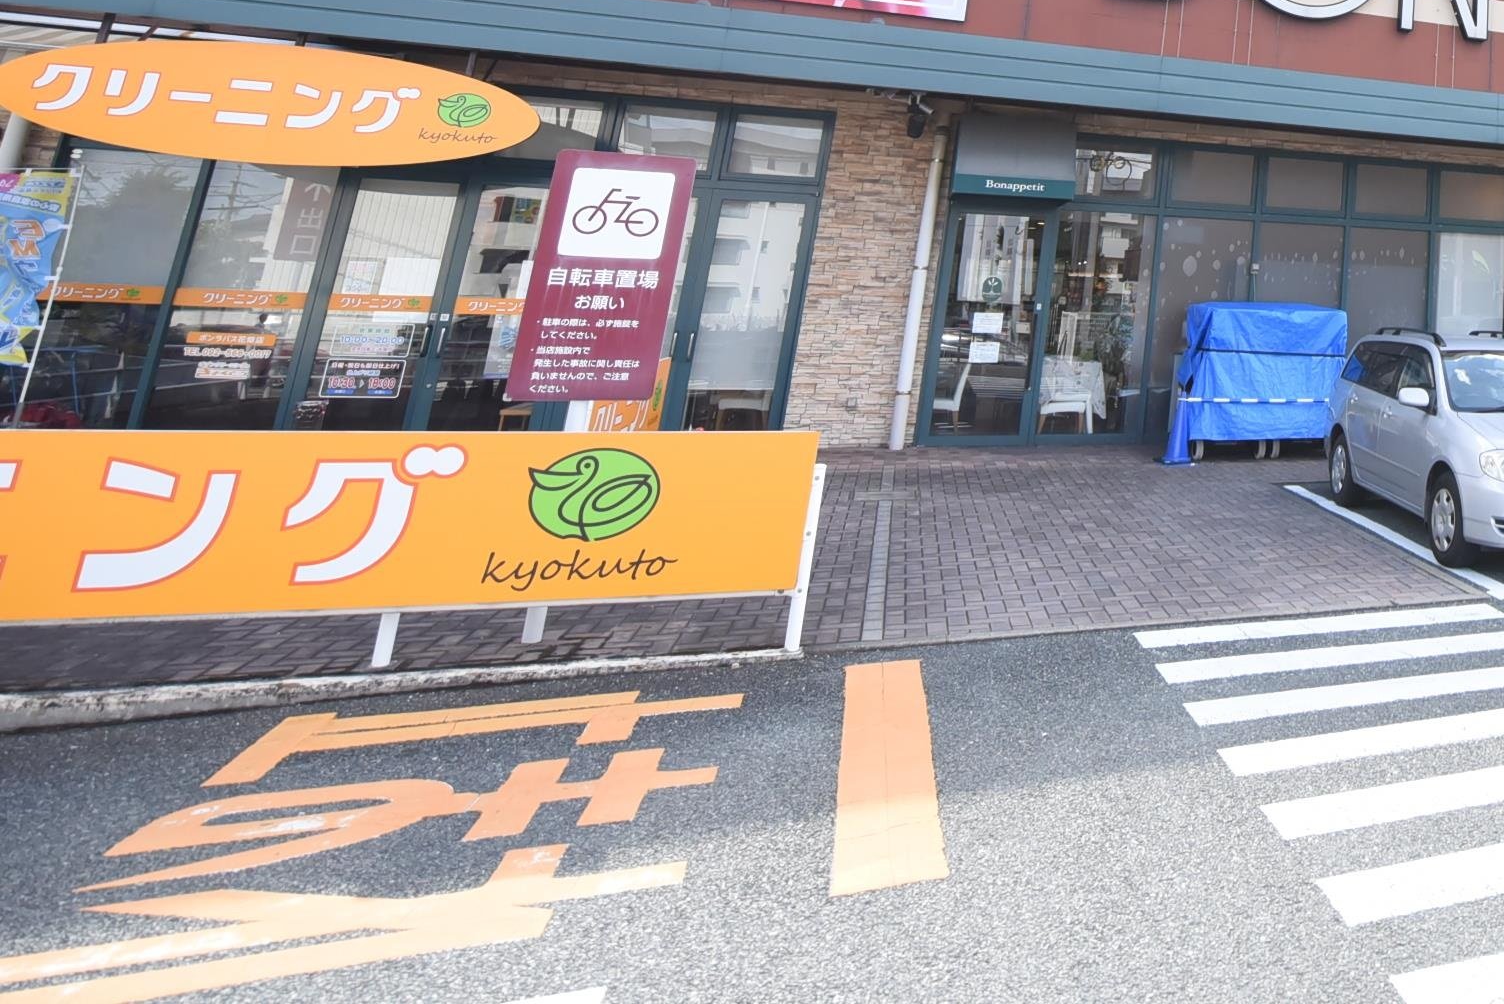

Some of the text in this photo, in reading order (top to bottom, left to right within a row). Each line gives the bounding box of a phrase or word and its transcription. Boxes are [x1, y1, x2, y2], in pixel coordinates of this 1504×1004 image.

[32, 62, 422, 134] クリーニング
[417, 127, 498, 144] kyokuto
[985, 179, 1046, 192] Bonappetit
[547, 267, 660, 289] 自転車置場
[202, 292, 272, 305] クリーニング
[339, 297, 407, 309] クリーニング
[574, 295, 625, 310] お願い
[481, 547, 679, 592] kyokuto
